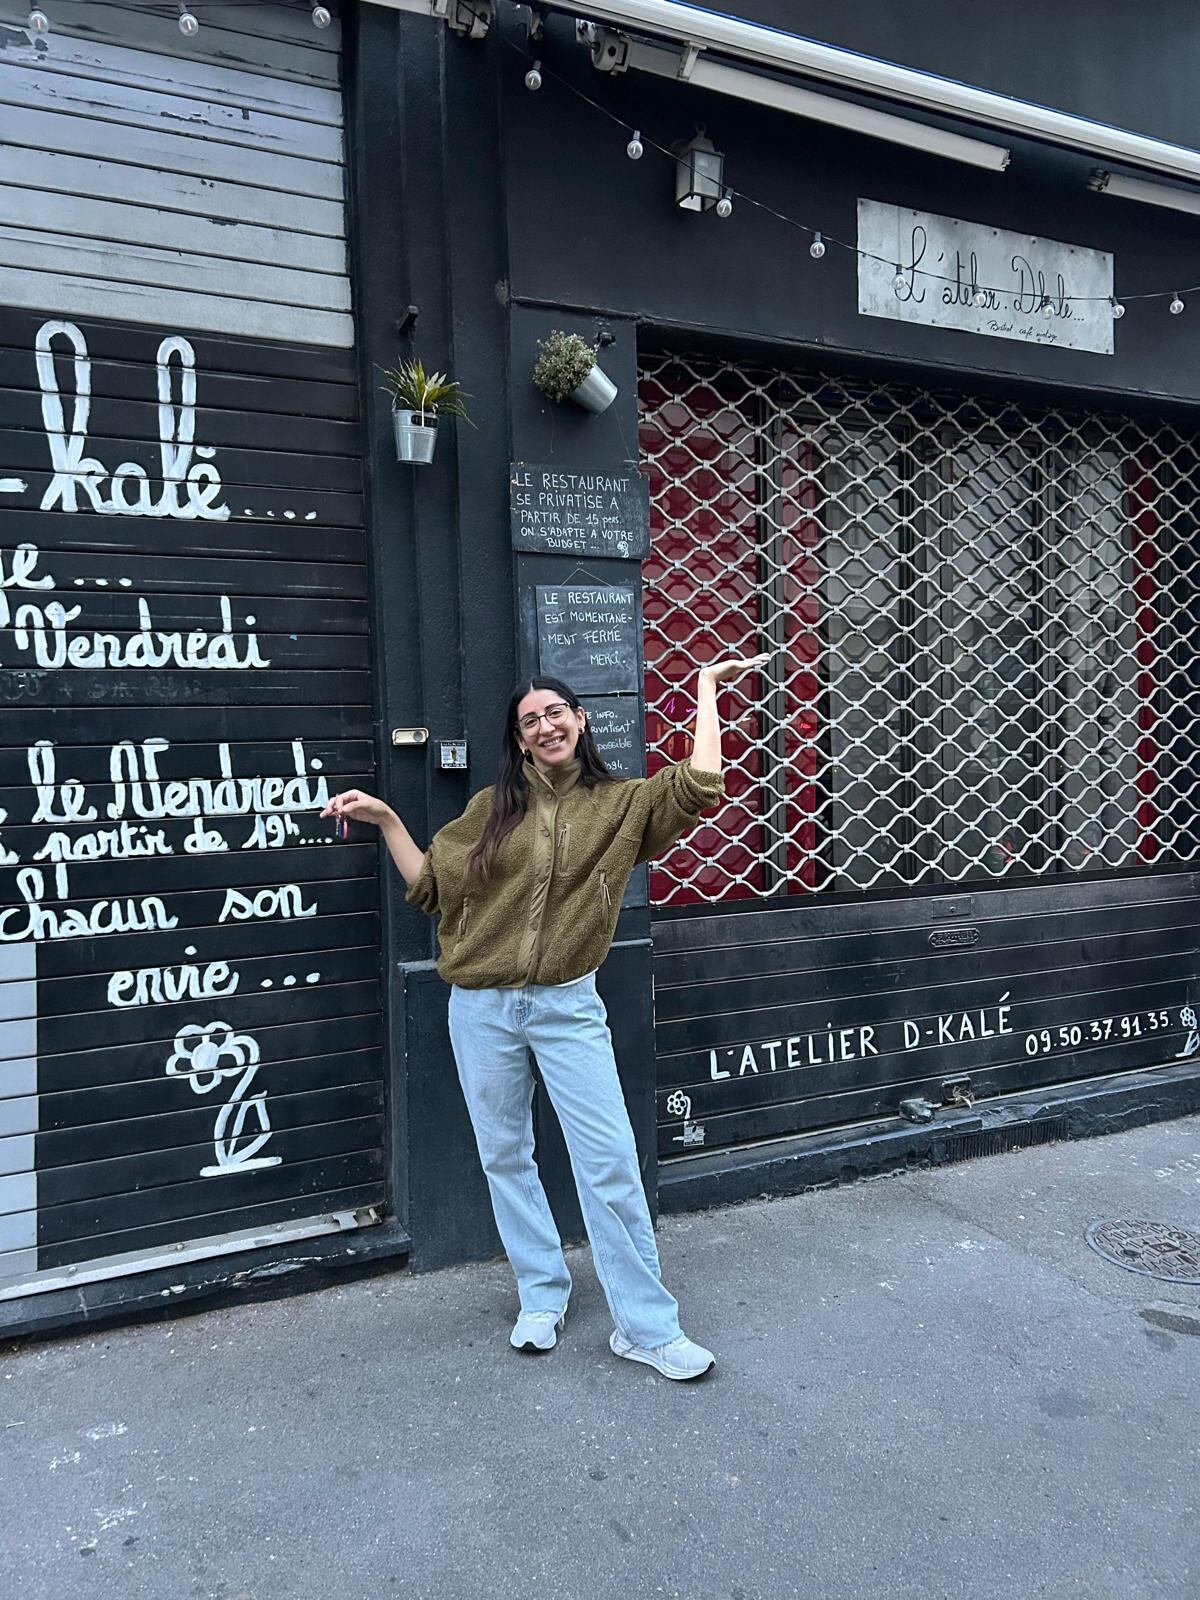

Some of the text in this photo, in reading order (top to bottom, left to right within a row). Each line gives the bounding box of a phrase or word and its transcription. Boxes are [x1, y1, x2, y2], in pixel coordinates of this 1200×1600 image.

[515, 472, 630, 493] LE RESTAURANT
[516, 493, 532, 506] SE
[609, 496, 620, 511] A
[520, 509, 561, 525] PARTIR
[567, 512, 582, 525] DE
[585, 513, 600, 526] 15
[520, 526, 634, 542] ON S'ADAPTE A VOTRE
[544, 591, 635, 605] LE RESTAURANT
[544, 611, 566, 624] EST
[14, 595, 272, 669] Vendredi
[581, 623, 623, 644] FERMÉ
[596, 737, 633, 753] possible
[28, 737, 330, 823] le Vendredi
[32, 820, 174, 899] partir
[183, 816, 230, 853] de
[218, 884, 318, 923] son
[106, 944, 240, 1007] envie
[902, 989, 1012, 1051] D-KALÉ
